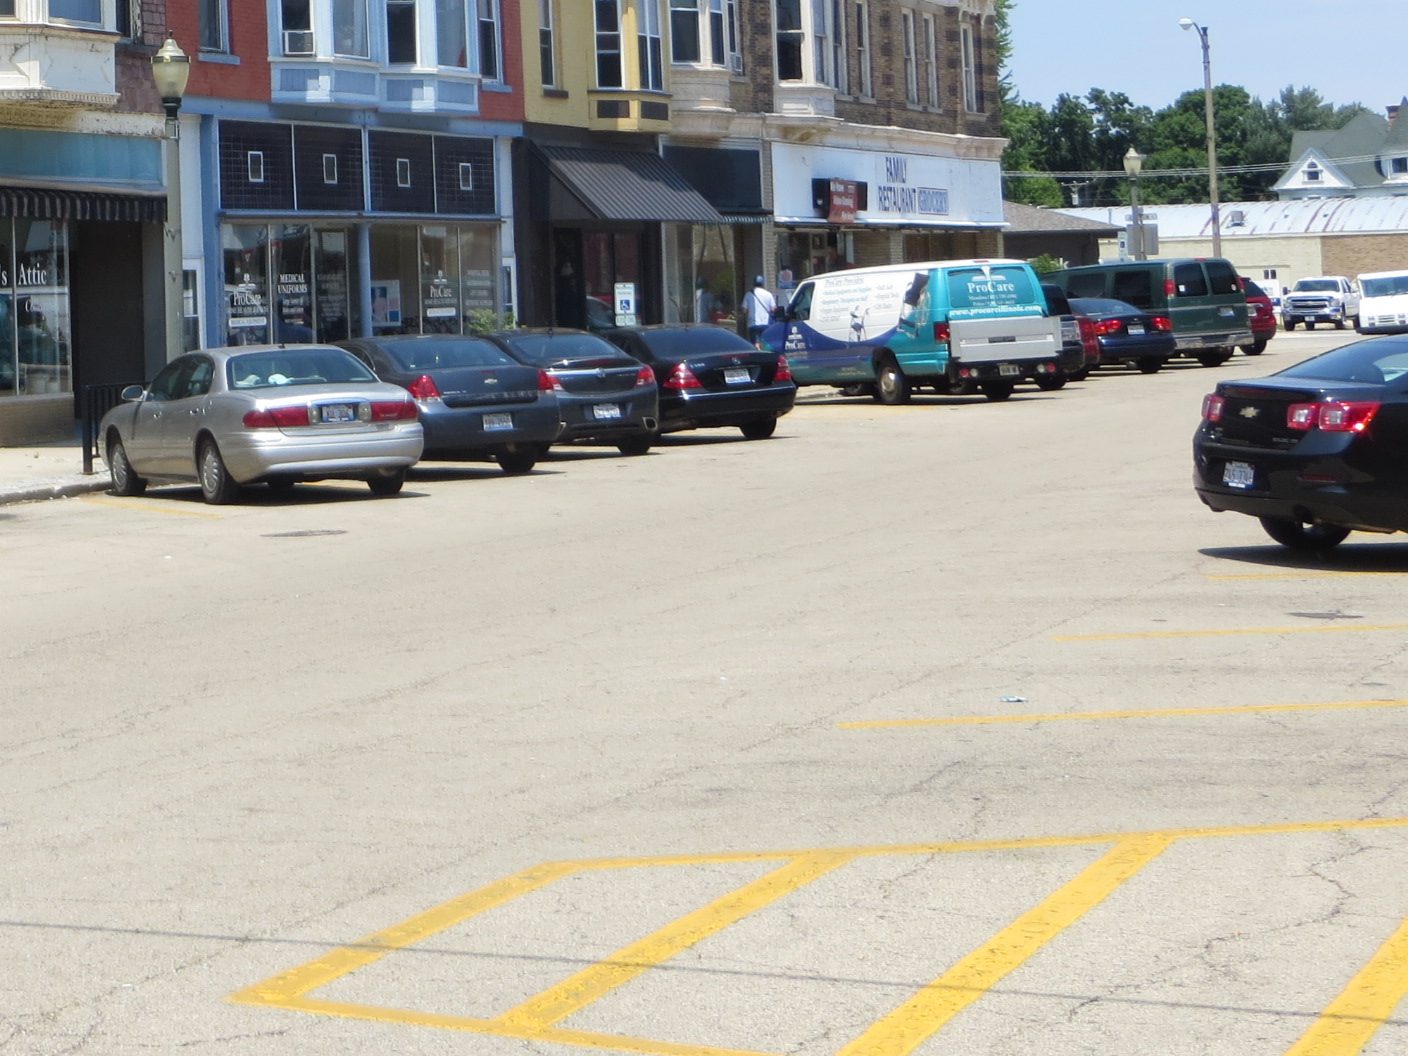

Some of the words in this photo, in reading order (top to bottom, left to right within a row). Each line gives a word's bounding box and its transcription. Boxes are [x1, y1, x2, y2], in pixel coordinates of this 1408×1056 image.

[885, 156, 907, 184] FAMILY
[878, 185, 917, 213] RESTAURANT
[18, 262, 47, 285] Attic
[279, 273, 306, 283] MEDICAL
[277, 284, 309, 294] UNIFORMS
[429, 285, 452, 298] ProCare
[966, 281, 1014, 294] ProCare
[233, 290, 262, 306] ProCare
[784, 340, 806, 350] ProCare
